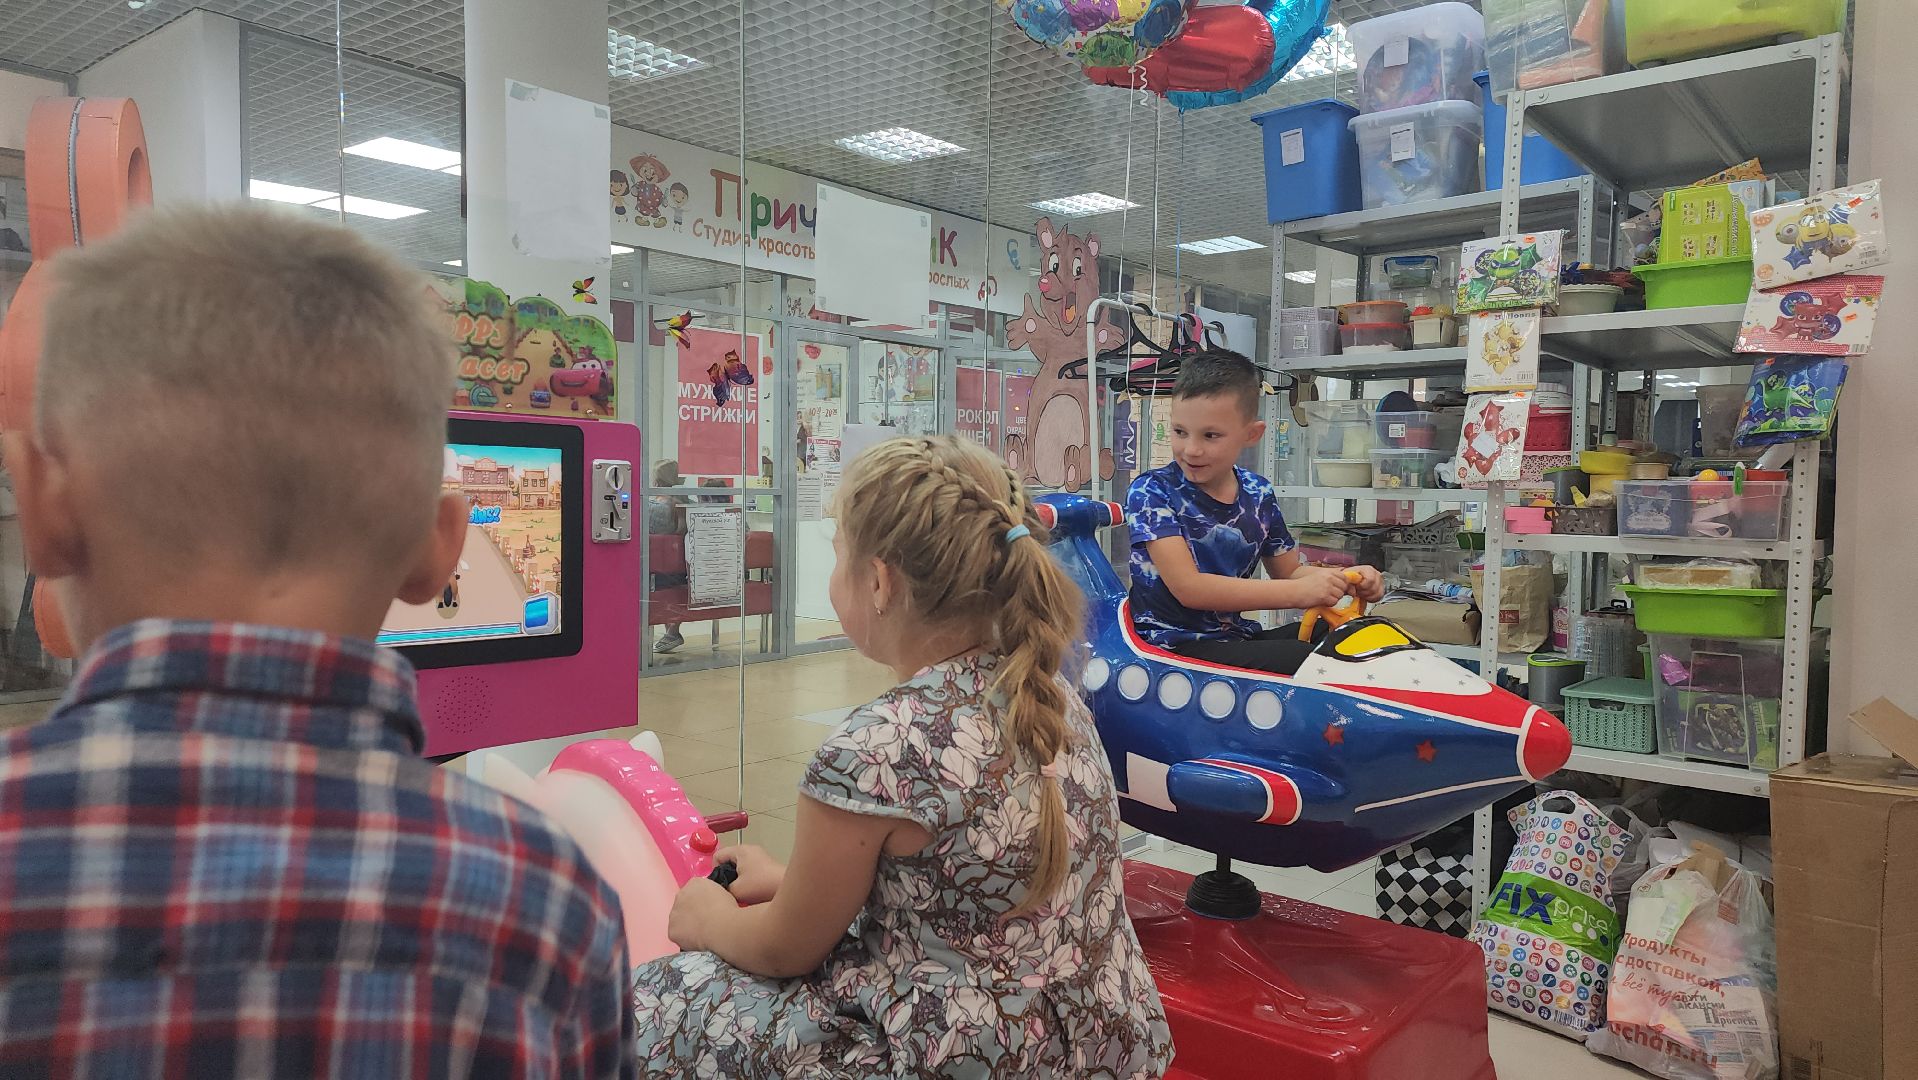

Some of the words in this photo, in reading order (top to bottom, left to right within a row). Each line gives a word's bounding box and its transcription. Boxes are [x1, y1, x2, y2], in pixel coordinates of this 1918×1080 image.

[692, 218, 751, 248] Студия
[678, 404, 756, 425] СТРИЖКИ
[956, 408, 999, 424] РОКОЛ
